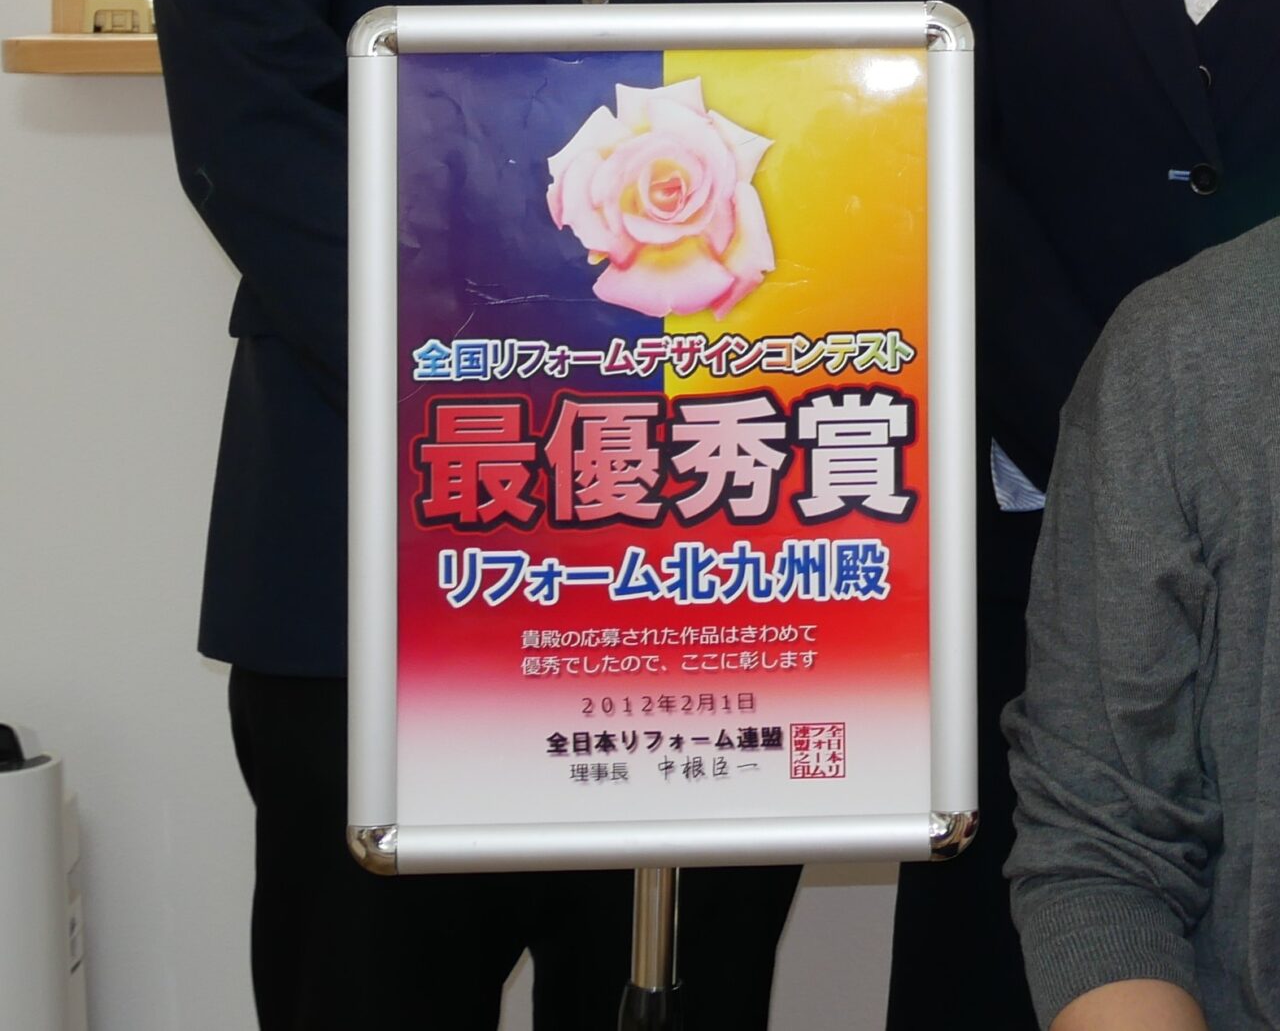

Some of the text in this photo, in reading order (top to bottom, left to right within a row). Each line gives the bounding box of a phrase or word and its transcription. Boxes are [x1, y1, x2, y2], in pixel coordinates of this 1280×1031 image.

[415, 332, 916, 381] 全国リフォームデザインコンテスト
[417, 389, 914, 526] 最優秀賞
[439, 538, 889, 607] リフォーム北九州殿
[521, 624, 818, 649] 貴殿の応募された作品はきわめて
[521, 650, 818, 675] 優秀でしたので、ここに彰します
[581, 692, 756, 715] 2012年2月1日
[546, 726, 783, 754] 全日本リフォーム連盟
[569, 762, 629, 782] 理事長
